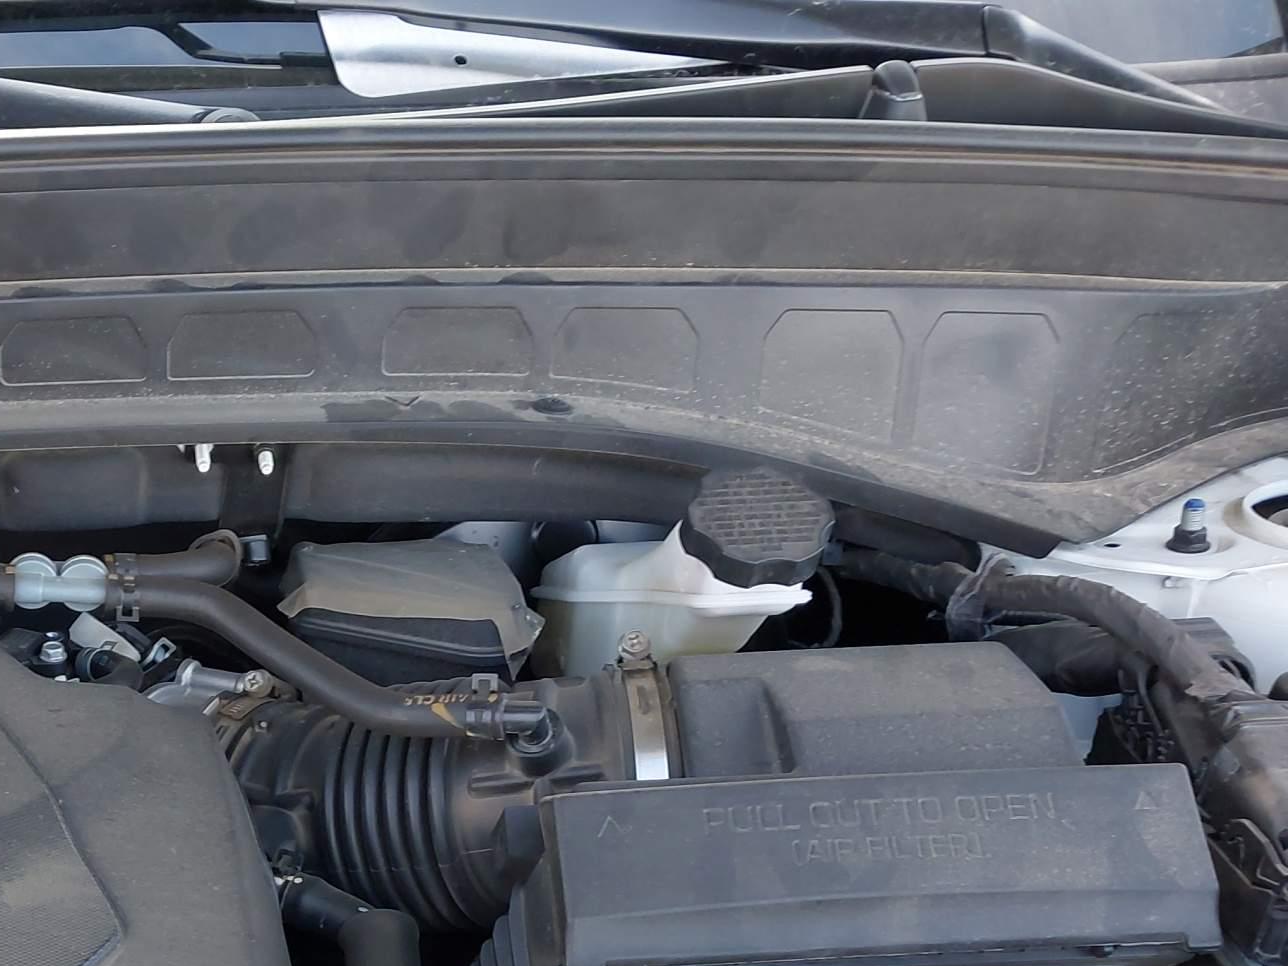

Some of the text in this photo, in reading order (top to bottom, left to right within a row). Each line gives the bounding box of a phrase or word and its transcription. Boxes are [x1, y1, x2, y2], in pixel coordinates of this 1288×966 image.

[702, 792, 1056, 834] PULL OUT TO OPEN
